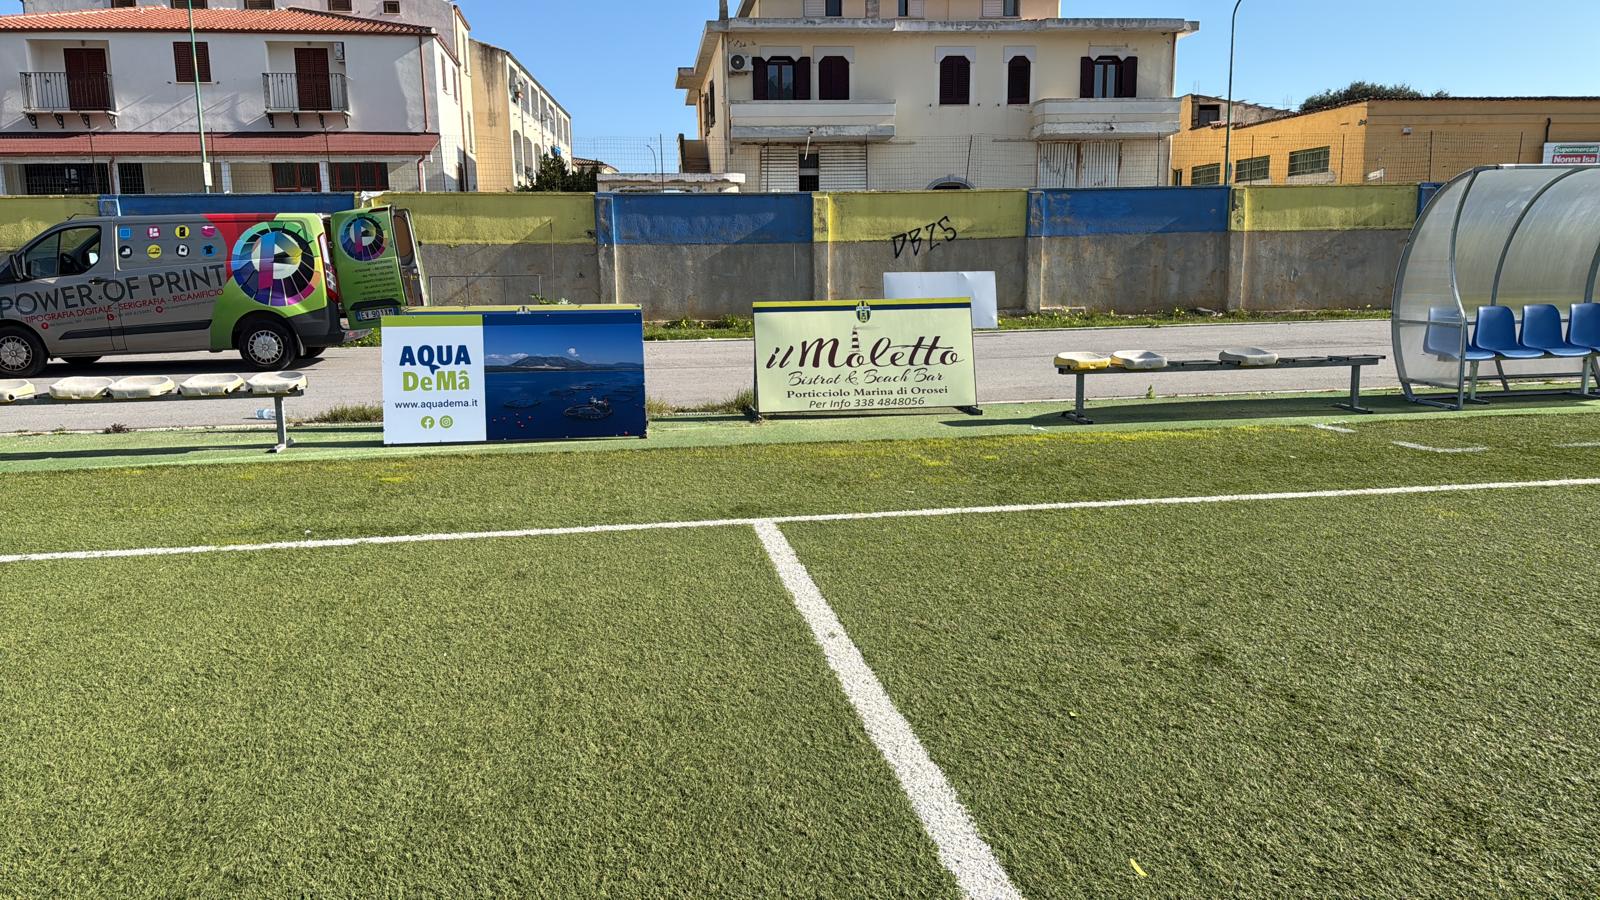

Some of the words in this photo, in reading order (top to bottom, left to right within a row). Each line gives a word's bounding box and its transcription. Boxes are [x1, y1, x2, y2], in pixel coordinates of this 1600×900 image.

[1553, 155, 1581, 163] Nonna
[1582, 155, 1595, 163] Isa
[0, 284, 96, 319] POWER
[103, 276, 139, 302] OF
[148, 264, 224, 296] PRINT
[24, 311, 76, 324] TIPOGRAFIA
[76, 305, 113, 318] DIGITALE
[118, 297, 167, 310] SERIGRAFIA
[172, 288, 224, 303] RICAMIFICIO
[399, 345, 471, 373] AQUA
[766, 345, 794, 369] il
[798, 336, 965, 369] Moletto
[788, 371, 841, 386] Bistrot
[845, 370, 859, 385] &
[863, 368, 911, 384] Beach
[914, 367, 944, 383] Bar
[786, 389, 850, 399] Porticciolo
[853, 387, 893, 397] Marina
[896, 386, 907, 395] di
[910, 385, 948, 395] Orosei
[394, 398, 478, 410] www.aquadema.it
[809, 400, 826, 409] Per
[830, 398, 851, 410] Info
[854, 398, 874, 407] 338
[877, 396, 925, 407] 4848056
